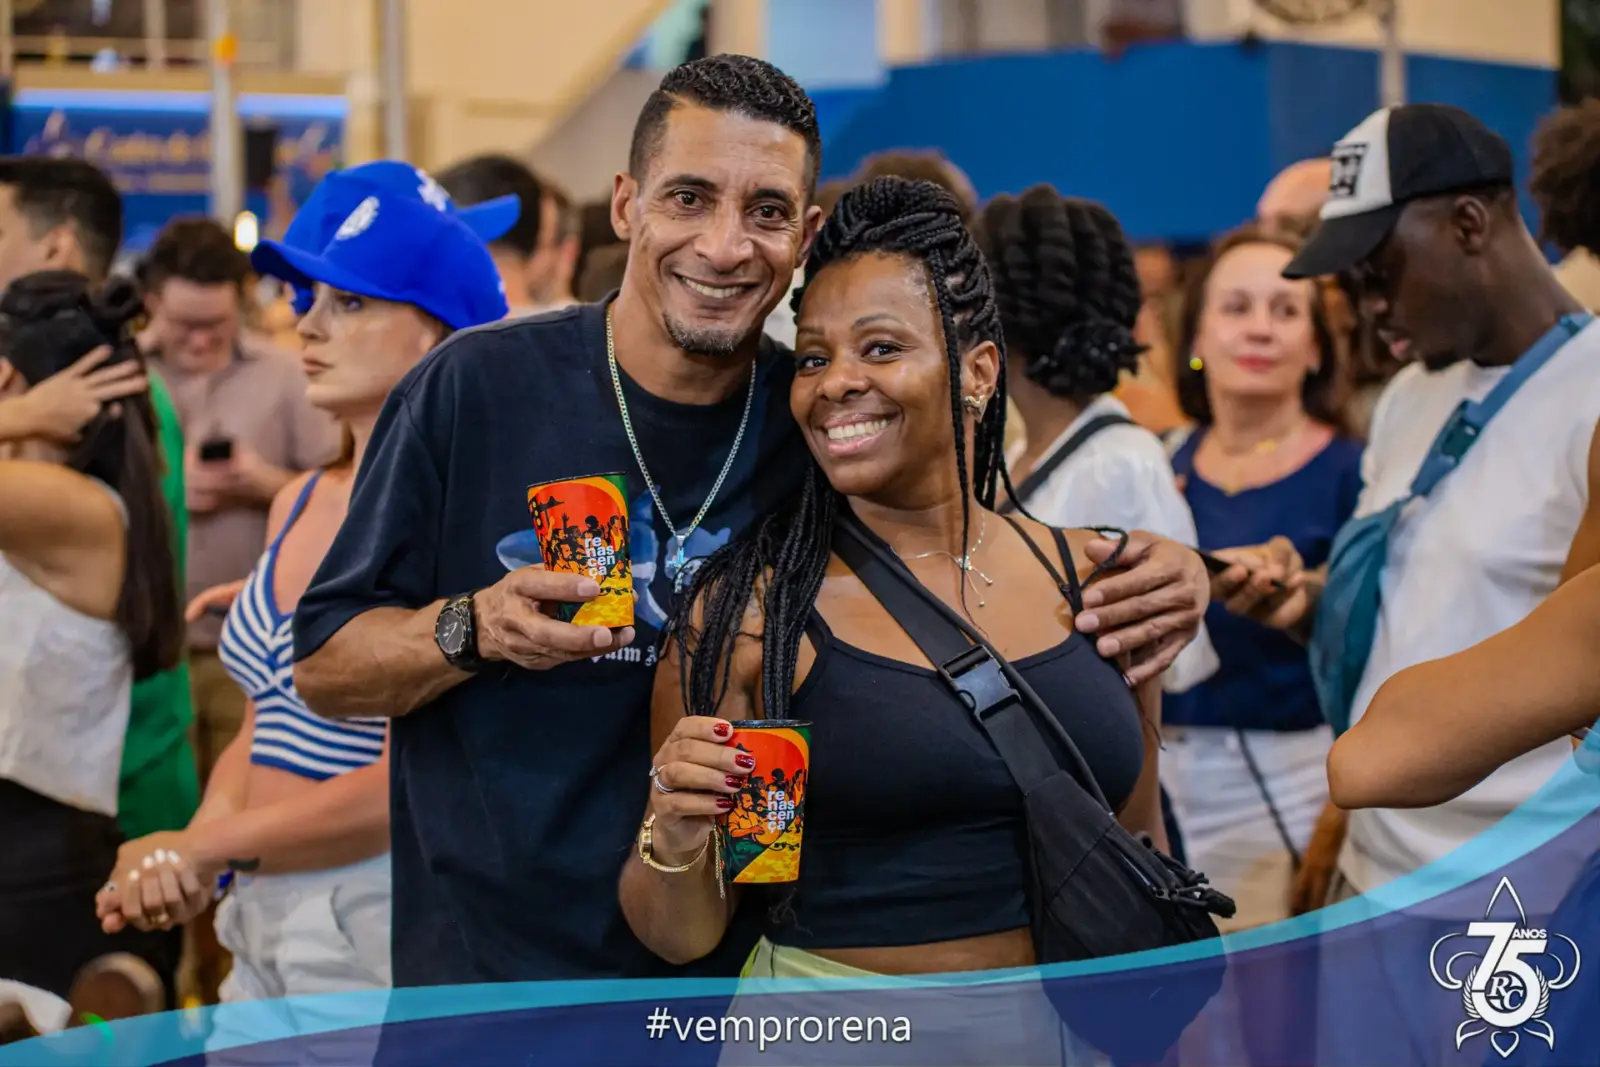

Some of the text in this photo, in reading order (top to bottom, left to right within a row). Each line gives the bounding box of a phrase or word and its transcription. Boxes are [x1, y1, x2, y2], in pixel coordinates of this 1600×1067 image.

[585, 537, 602, 548] re
[586, 545, 614, 557] nas
[587, 555, 615, 568] cen
[591, 647, 641, 663] alm
[768, 790, 785, 801] re
[768, 800, 795, 811] nas
[768, 810, 795, 821] cen
